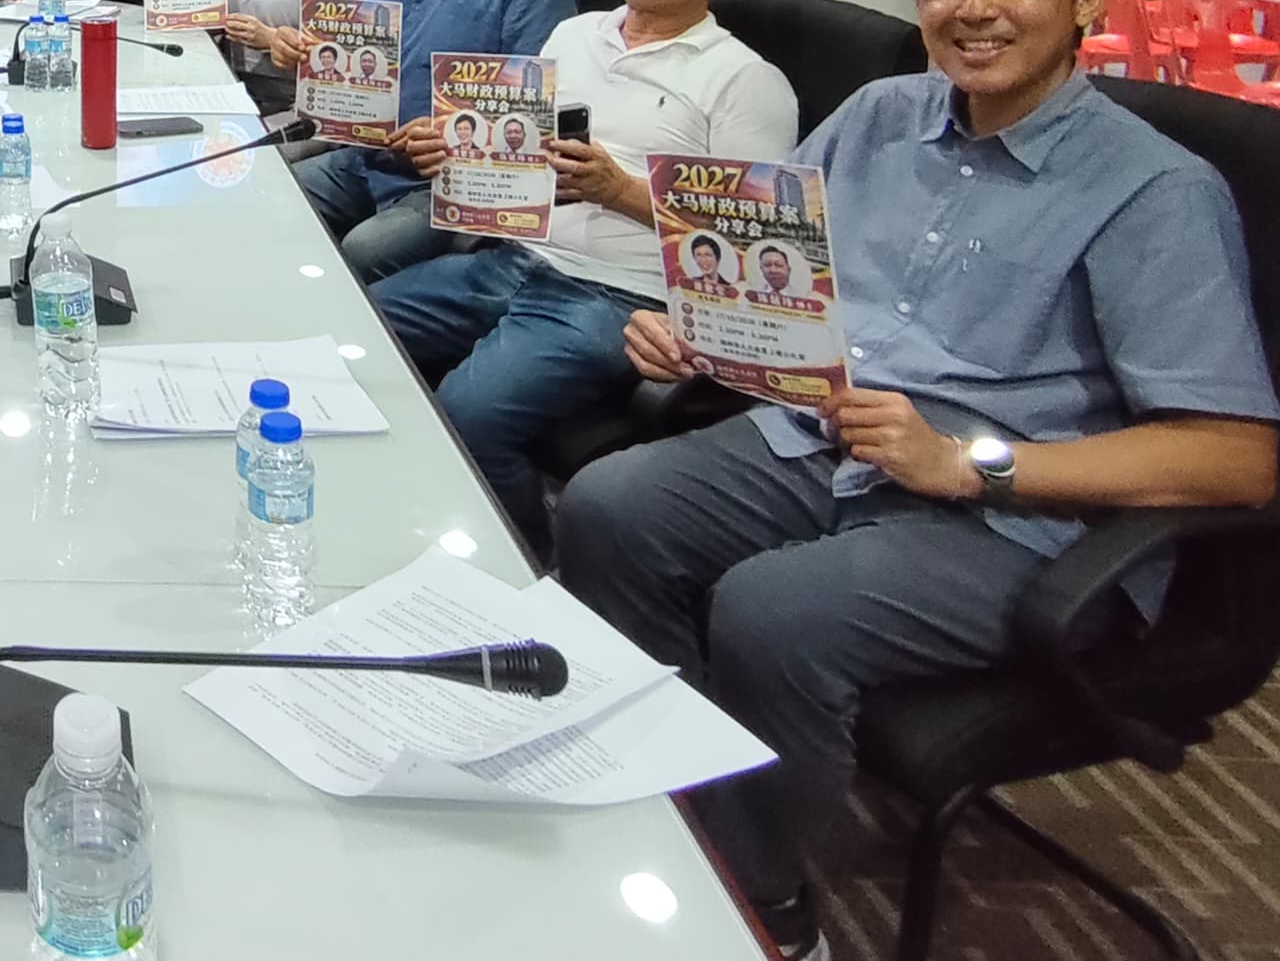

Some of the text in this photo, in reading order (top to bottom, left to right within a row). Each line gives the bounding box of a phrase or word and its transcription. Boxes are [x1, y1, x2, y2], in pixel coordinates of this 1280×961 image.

[314, 2, 358, 20] 2027
[449, 61, 502, 81] 2027
[440, 82, 536, 102] 大马财政预算案
[474, 99, 510, 113] 分享会
[672, 162, 744, 194] 2027
[662, 190, 800, 225] 大马财政预算案
[714, 217, 763, 238] 分享会
